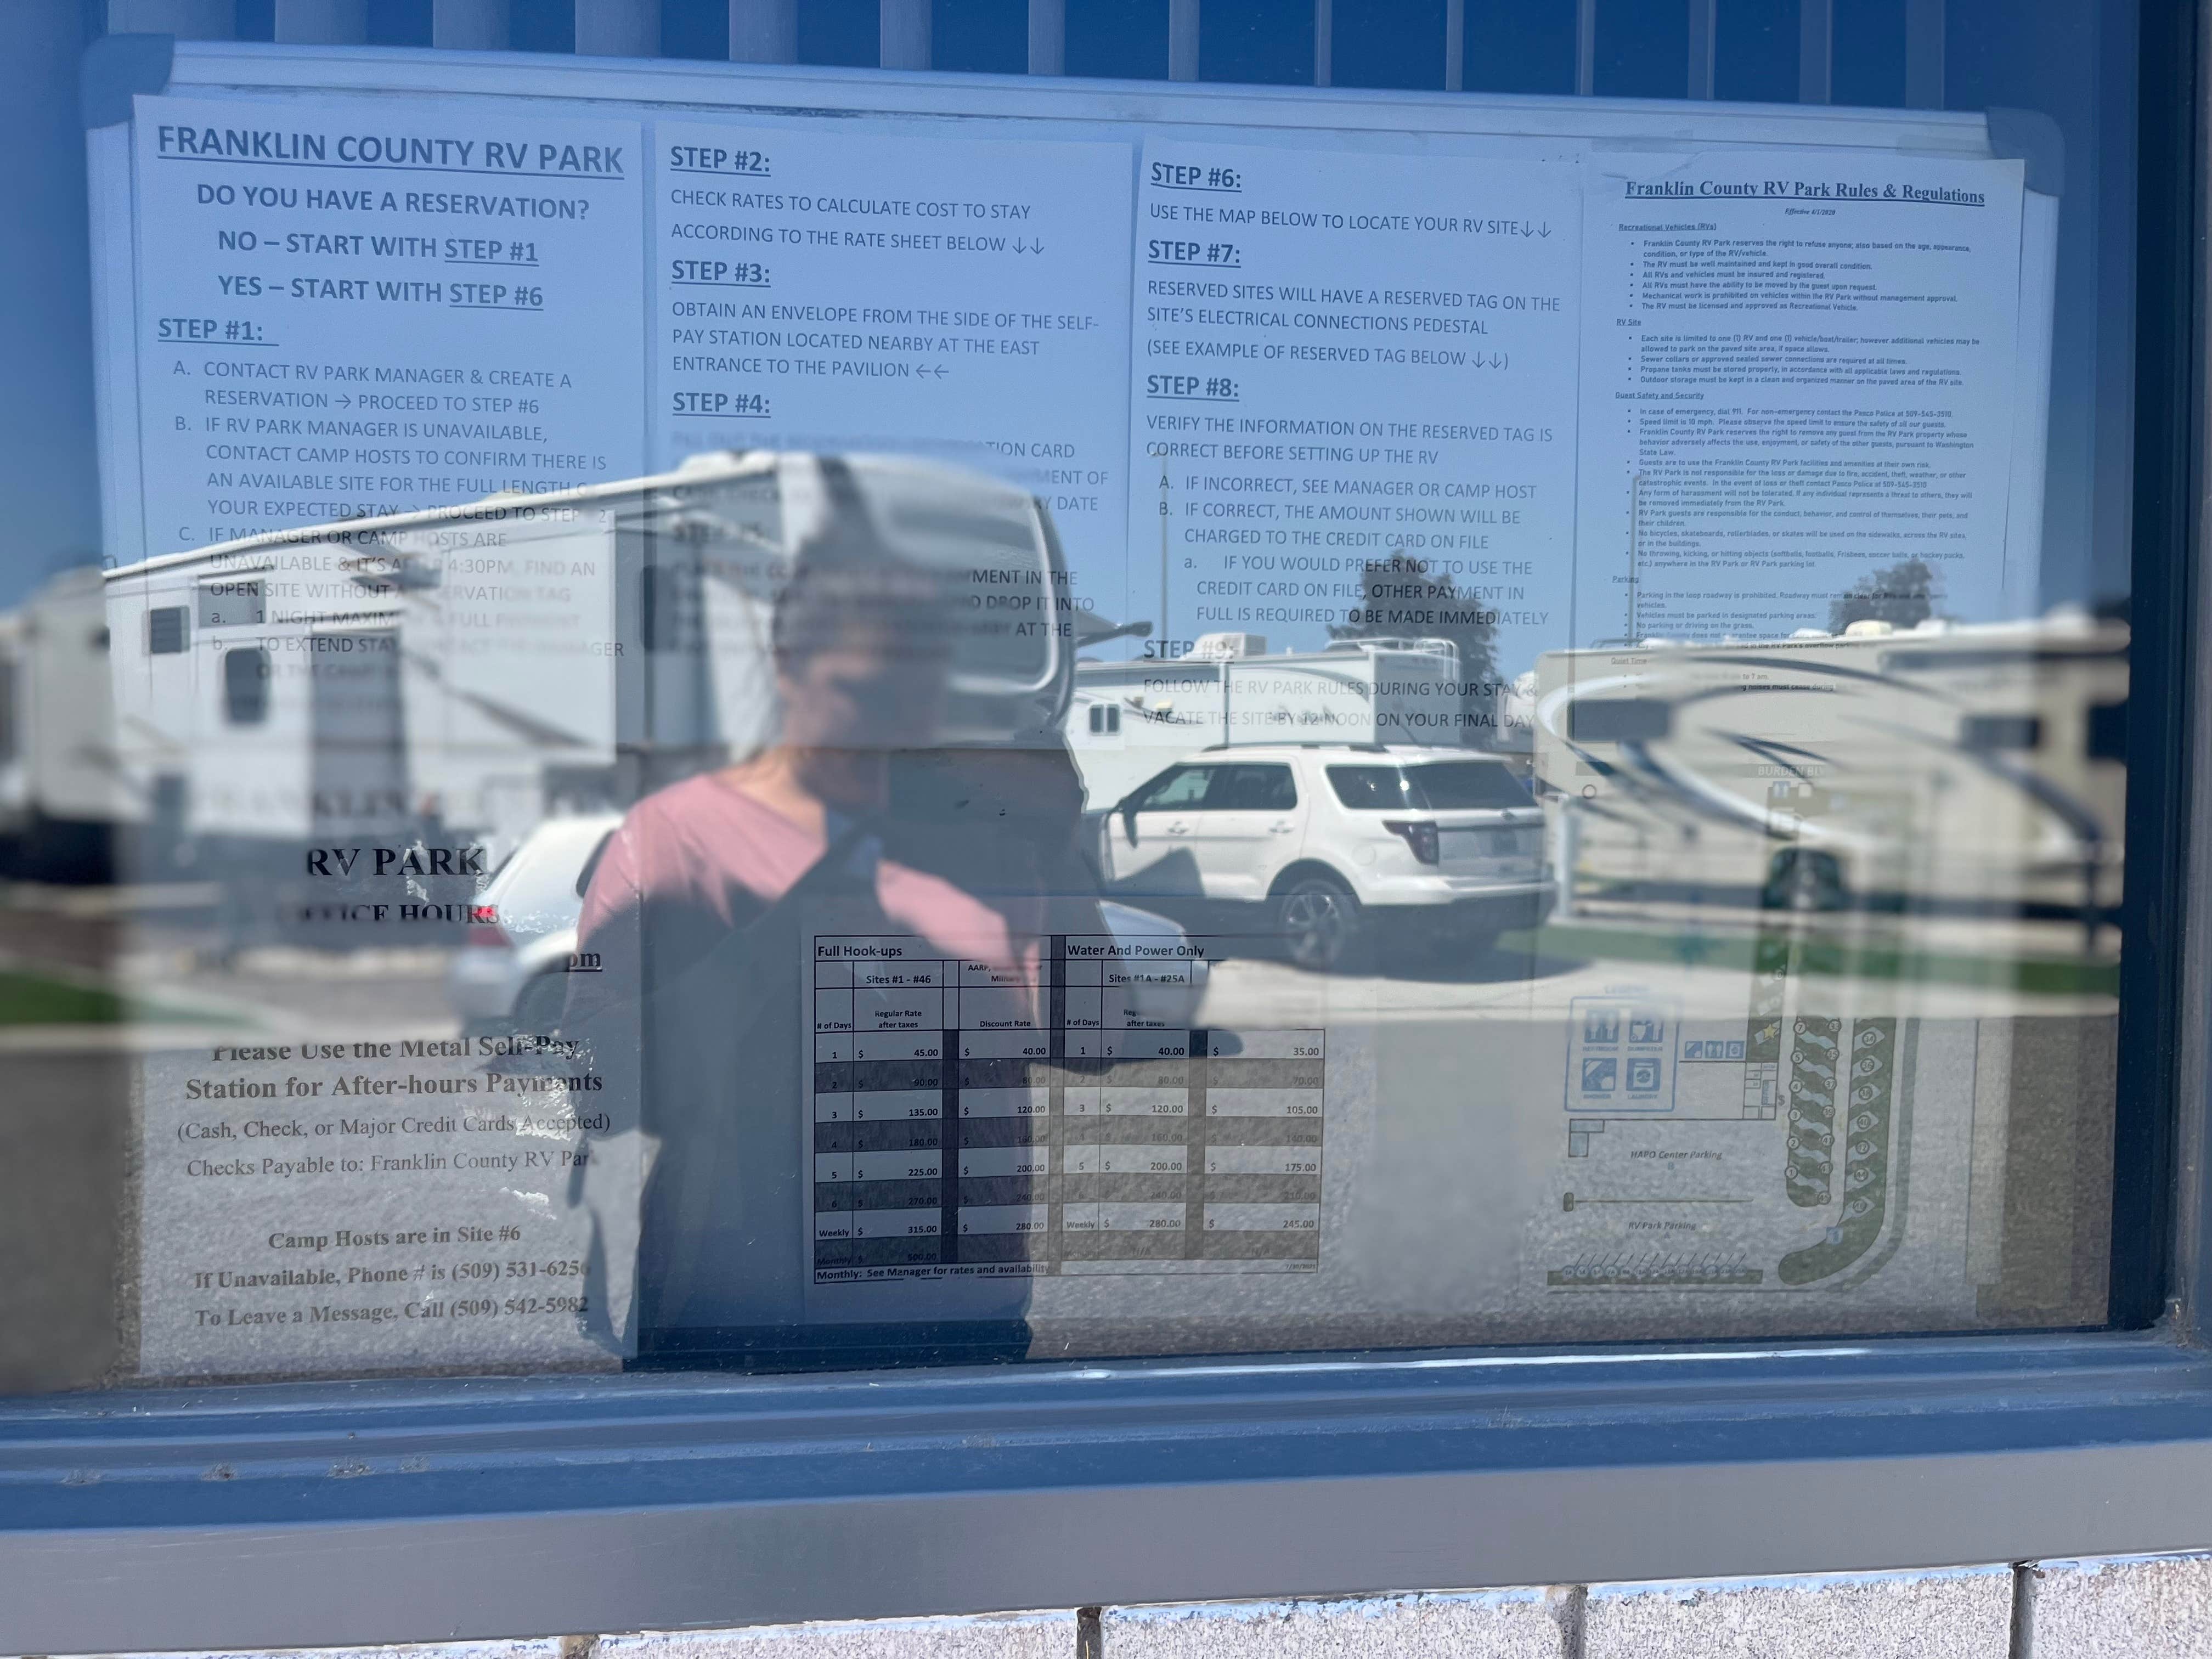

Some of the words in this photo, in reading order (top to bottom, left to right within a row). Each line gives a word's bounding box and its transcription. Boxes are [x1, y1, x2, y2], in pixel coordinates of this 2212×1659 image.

[159, 125, 325, 161] FRANKLIN
[337, 136, 475, 166] COUNTY
[486, 142, 528, 168] RV
[539, 144, 623, 173] PARK
[671, 145, 727, 169] STEP
[734, 150, 769, 172] #2:
[1151, 161, 1201, 185] STEP
[1207, 167, 1240, 188] #6:
[197, 184, 235, 205] DO
[242, 185, 297, 208] YOU
[307, 189, 373, 211] HAVE
[380, 191, 398, 212] A
[405, 192, 589, 220] RESERVATION?
[1625, 180, 1695, 196] Franklin
[1699, 180, 1759, 198] County
[1763, 180, 1791, 195] RV
[1794, 181, 1831, 198] Park
[1835, 182, 1878, 198] Rules
[1882, 183, 1897, 199] &
[1901, 184, 1985, 204] Regulations
[671, 189, 726, 207] CHECK
[732, 193, 783, 210] RATES
[788, 196, 811, 211] TO
[817, 198, 910, 216] CALCULATE
[916, 202, 958, 217] COST
[963, 203, 985, 218] TO
[990, 204, 1030, 219] STAY
[1150, 202, 1178, 220] USE
[1183, 206, 1214, 222] THE
[1219, 208, 1256, 224] MAP
[1261, 211, 1318, 227] BELOW
[1322, 214, 1344, 229] TO
[1349, 215, 1409, 230] LOCATE
[1414, 216, 1458, 232] YOUR
[1463, 218, 1483, 233] RV
[1487, 220, 1518, 235] SITE
[218, 230, 257, 251] NO
[286, 233, 364, 256] START
[370, 236, 436, 258] WITH
[444, 238, 503, 259] STEP
[509, 241, 538, 262] #1
[671, 223, 772, 242] ACCORDING
[778, 229, 802, 244] TO
[806, 230, 838, 246] THE
[844, 232, 885, 247] RATE
[890, 234, 941, 250] SHEET
[947, 236, 1006, 251] BELOW
[1148, 239, 1200, 261] STEP
[1206, 243, 1240, 263] #7:
[672, 259, 727, 281] STEP
[734, 262, 769, 283] #3:
[218, 275, 262, 296] YES
[291, 278, 369, 300] START
[376, 281, 441, 303] WITH
[449, 283, 506, 304] STEP
[514, 286, 543, 307] #6
[159, 318, 217, 338] STEP
[225, 320, 262, 341] #1:
[1616, 318, 1627, 326] RV
[1627, 318, 1642, 326] Site
[1147, 374, 1199, 395] STEP
[1206, 377, 1238, 397] #8:
[673, 392, 728, 413] STEP
[735, 394, 769, 414] #4:
[307, 849, 360, 876] RV
[373, 848, 484, 876] PARK
[817, 945, 839, 957] Full
[843, 945, 902, 958] Hook-ups
[1067, 945, 1105, 956] Water
[1108, 944, 1131, 956] And
[1135, 945, 1173, 956] Power
[1176, 945, 1204, 958] Only
[866, 975, 890, 984] Sites
[892, 975, 904, 984] #1
[913, 975, 931, 984] #46
[1109, 974, 1131, 983] Sites
[1160, 974, 1184, 983] #25A
[913, 1048, 938, 1057] 45.00
[1022, 1047, 1046, 1056] 40.00
[1158, 1047, 1184, 1056] 40.00
[1293, 1047, 1319, 1056] 35.00
[186, 1077, 276, 1100] Station
[285, 1076, 323, 1097] for
[331, 1074, 477, 1096] After-hours
[909, 1108, 938, 1117] 135.00
[187, 1159, 255, 1177] Checks
[262, 1156, 334, 1178] Payable
[341, 1158, 363, 1172] to:
[370, 1153, 446, 1171] Franklin
[453, 1153, 518, 1172] County
[524, 1150, 555, 1167] RV
[561, 1150, 593, 1167] Par
[908, 1167, 938, 1177] 225.00
[1017, 1164, 1045, 1173] 200.00
[1150, 1161, 1182, 1171] 200.00
[1285, 1163, 1316, 1172] 175.00
[819, 1228, 849, 1237] Weekly
[907, 1225, 937, 1234] 315.00
[1283, 1220, 1314, 1228] 245.00
[268, 1233, 328, 1252] Camp
[335, 1230, 390, 1246] Hosts
[396, 1232, 427, 1244] are
[433, 1227, 450, 1243] in
[458, 1226, 493, 1242] Site
[499, 1225, 521, 1242] #6
[195, 1272, 213, 1289] If
[218, 1269, 341, 1288] Unavailable,
[348, 1267, 408, 1284] Phone
[415, 1264, 426, 1279] #
[431, 1264, 445, 1280] is
[452, 1262, 499, 1282] (509)
[195, 1310, 221, 1326] To
[228, 1308, 286, 1326] Leave
[292, 1311, 302, 1323] a
[310, 1305, 398, 1324] Message,
[404, 1301, 443, 1319] Call
[450, 1299, 498, 1318] (509)
[504, 1296, 588, 1316] 542-5982
